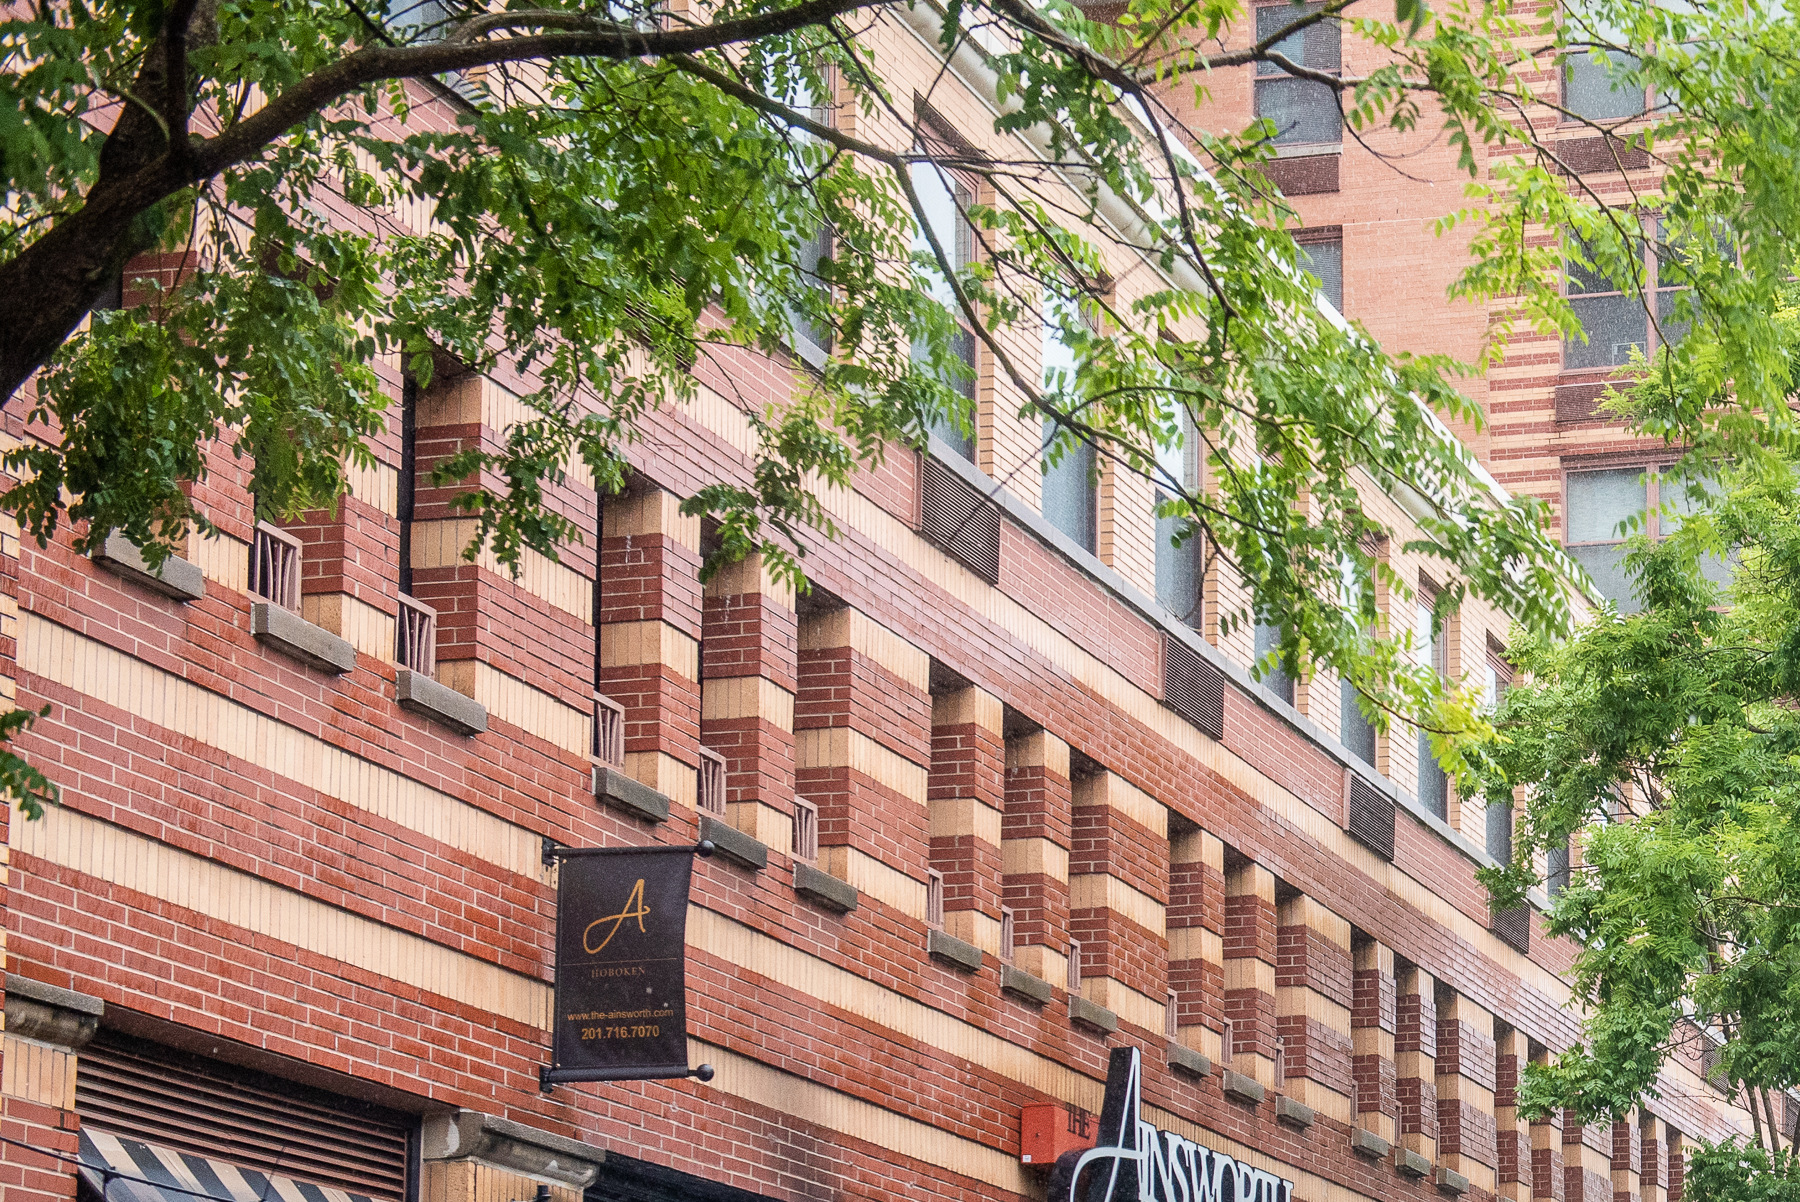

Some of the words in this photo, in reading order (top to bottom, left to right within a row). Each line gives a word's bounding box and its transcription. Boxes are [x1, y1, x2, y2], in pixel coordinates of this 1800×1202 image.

[582, 878, 651, 954] A
[591, 966, 646, 979] HOBOKEN
[567, 1007, 674, 1022] www.the-ainsworth.com
[581, 1024, 660, 1041] 201.716.7070
[1065, 1102, 1091, 1141] THE
